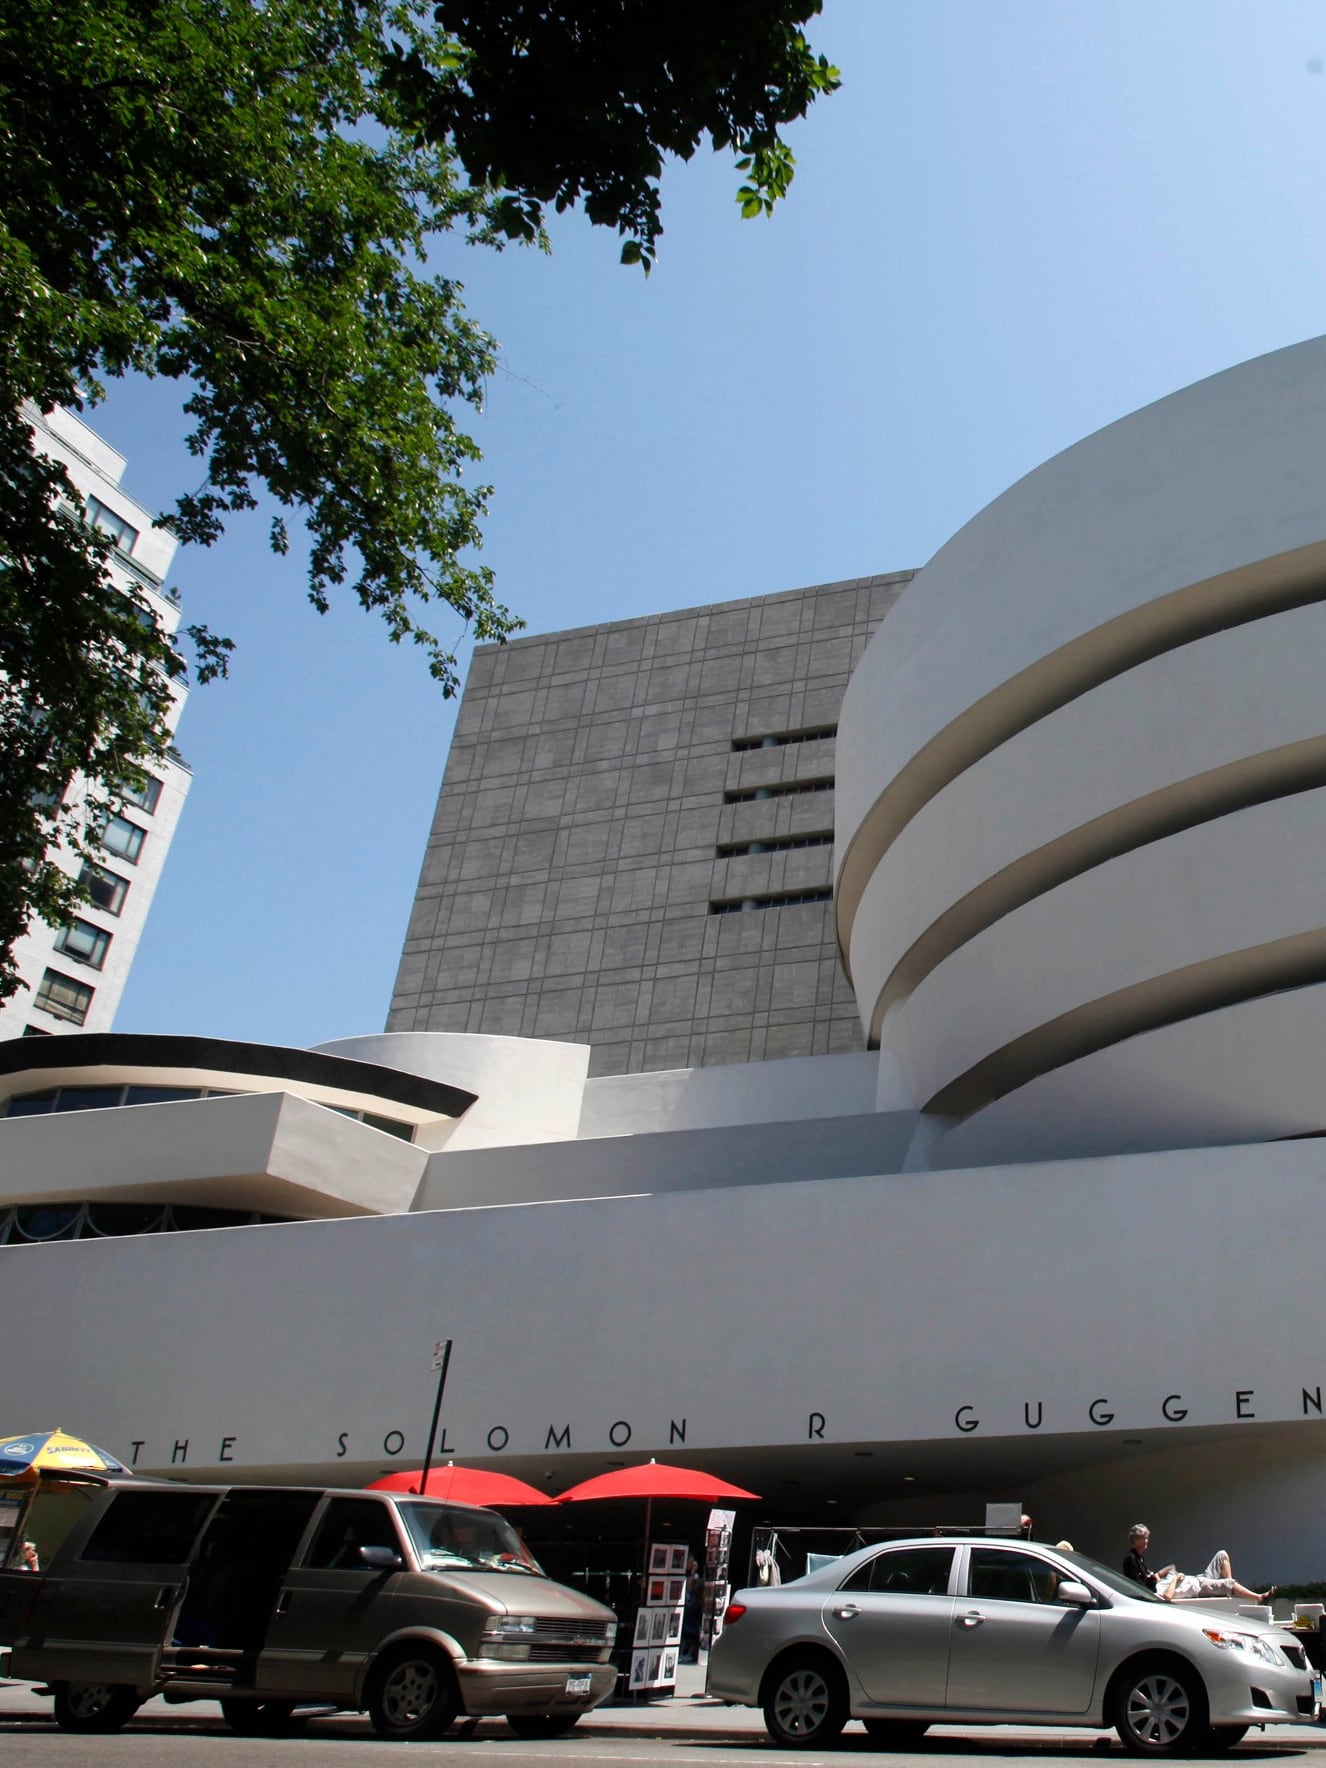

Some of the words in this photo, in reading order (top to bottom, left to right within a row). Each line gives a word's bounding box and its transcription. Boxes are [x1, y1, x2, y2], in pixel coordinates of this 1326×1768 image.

[130, 1437, 238, 1466] THE
[336, 1418, 687, 1458] SOLOMON
[808, 1411, 826, 1440] R
